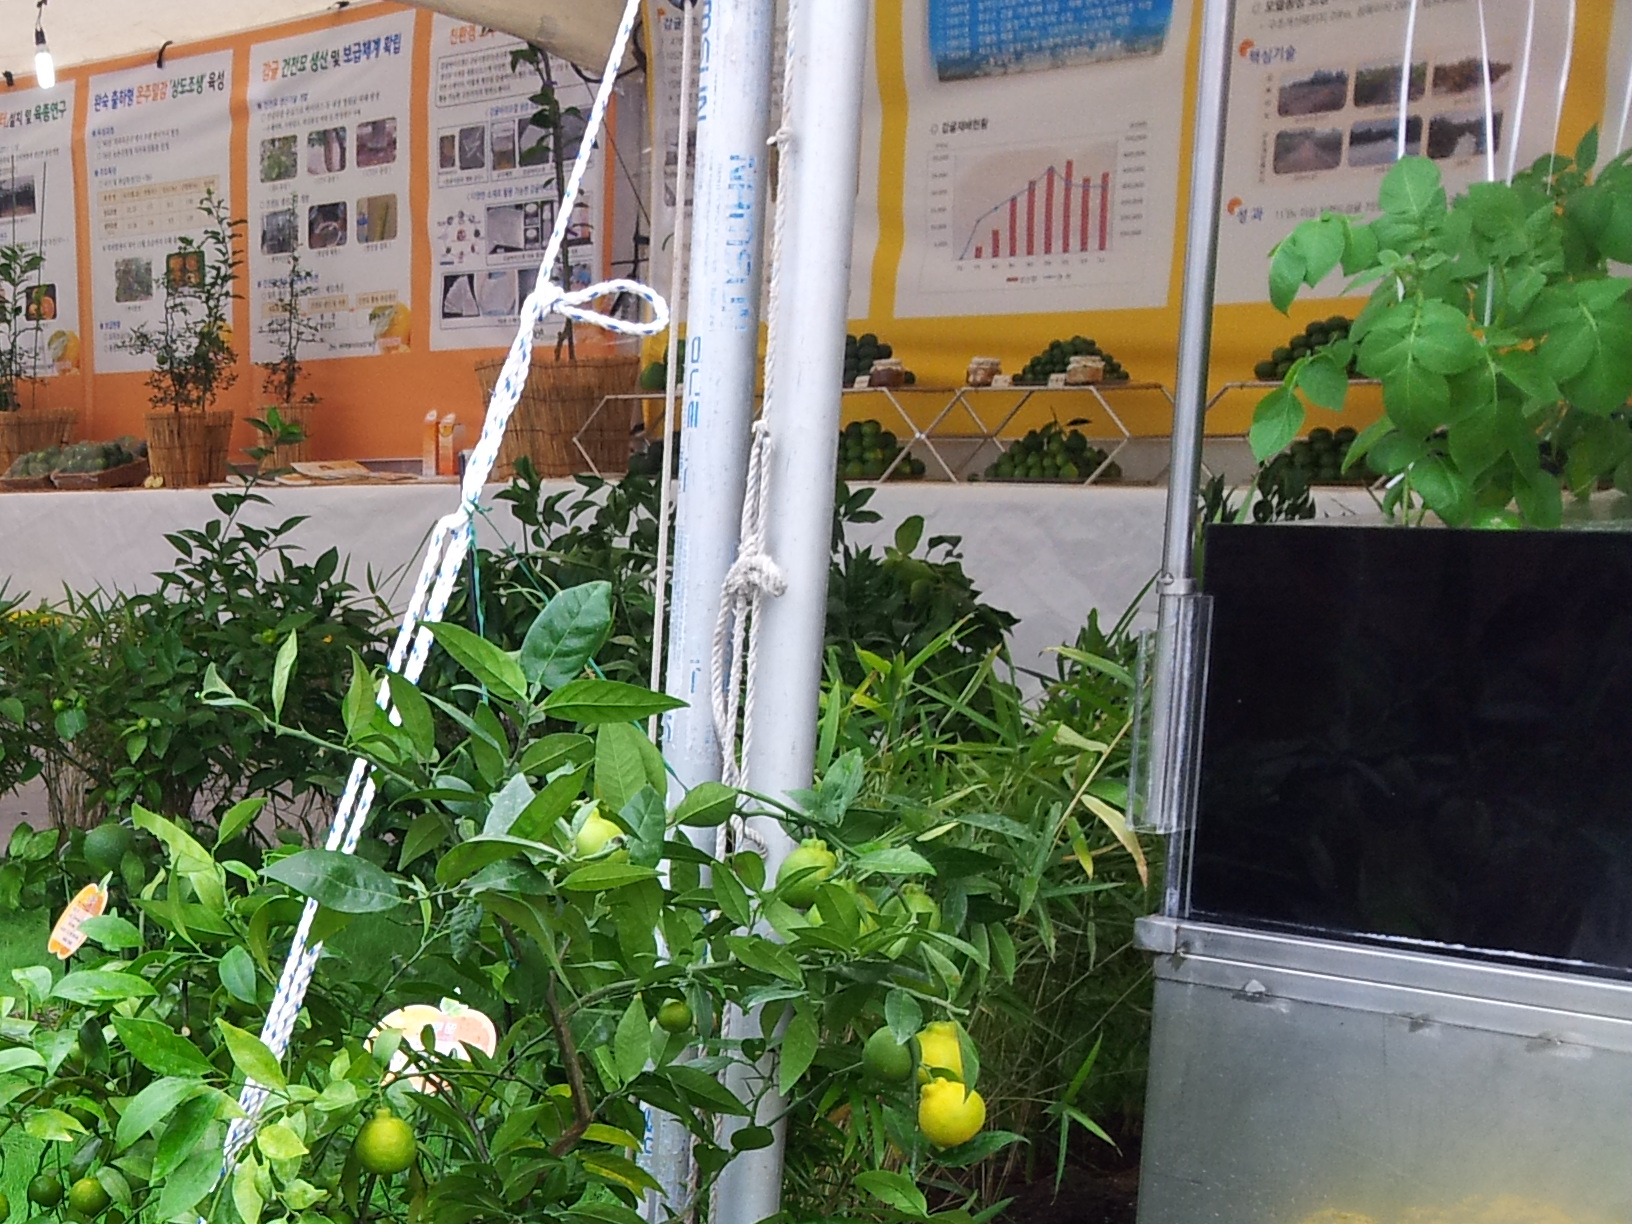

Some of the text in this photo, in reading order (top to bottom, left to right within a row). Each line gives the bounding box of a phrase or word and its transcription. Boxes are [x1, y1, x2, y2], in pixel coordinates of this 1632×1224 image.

[261, 60, 280, 83] 감귤
[309, 49, 330, 73] 생산
[330, 49, 341, 68] 및
[342, 37, 382, 65] 보급체계
[383, 33, 403, 56] 확립
[1248, 44, 1297, 65] 핵심기술
[135, 80, 169, 106] 온주밀감
[207, 70, 226, 92] 육성
[24, 109, 33, 125] 및
[33, 100, 68, 122] 육종연구
